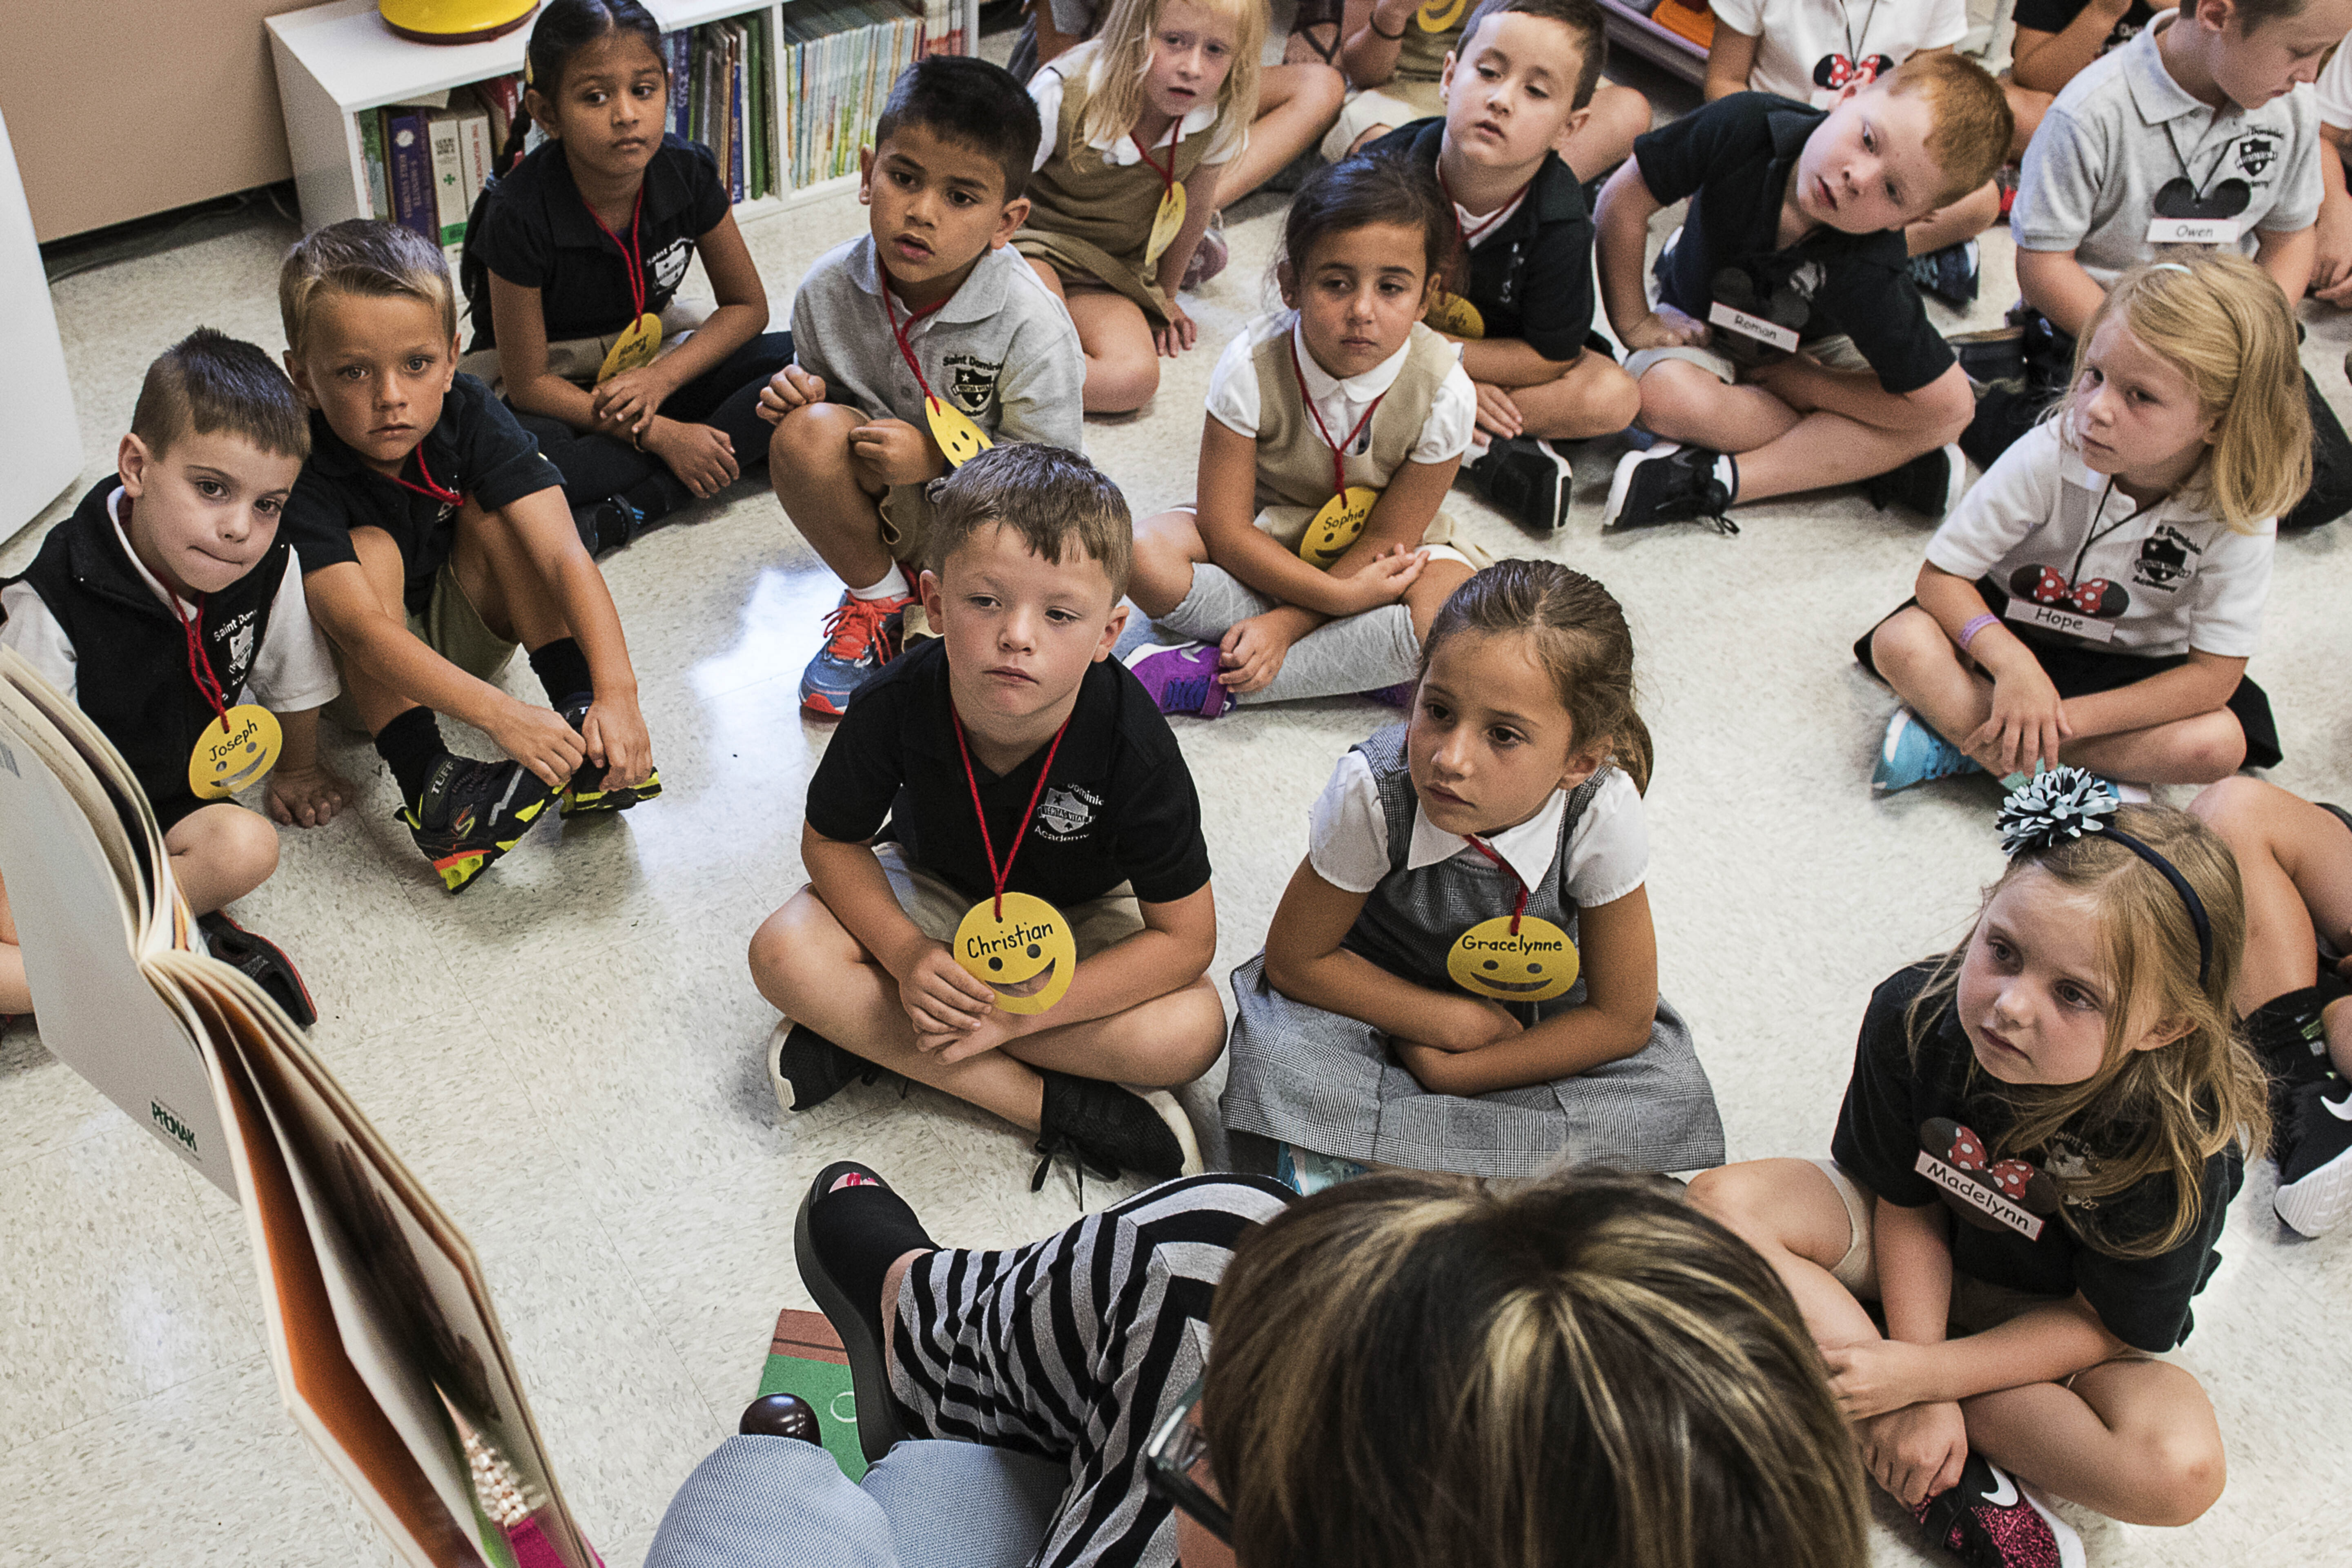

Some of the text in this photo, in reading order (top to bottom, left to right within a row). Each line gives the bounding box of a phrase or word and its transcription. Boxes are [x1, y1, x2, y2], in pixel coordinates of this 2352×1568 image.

[2176, 225, 2214, 238] Owen
[1734, 314, 1777, 340] Roman
[943, 354, 967, 367] Saint
[1323, 505, 1365, 531] Sophia
[214, 619, 238, 641] Saint
[2036, 608, 2083, 631] Hope
[209, 719, 258, 762] Joseph
[1044, 806, 1068, 819] VERITAS
[967, 922, 1054, 958] Christian
[1461, 933, 1563, 956] Gracelynne
[2054, 1131, 2082, 1146] aint
[1927, 1162, 2030, 1230] Madelynn
